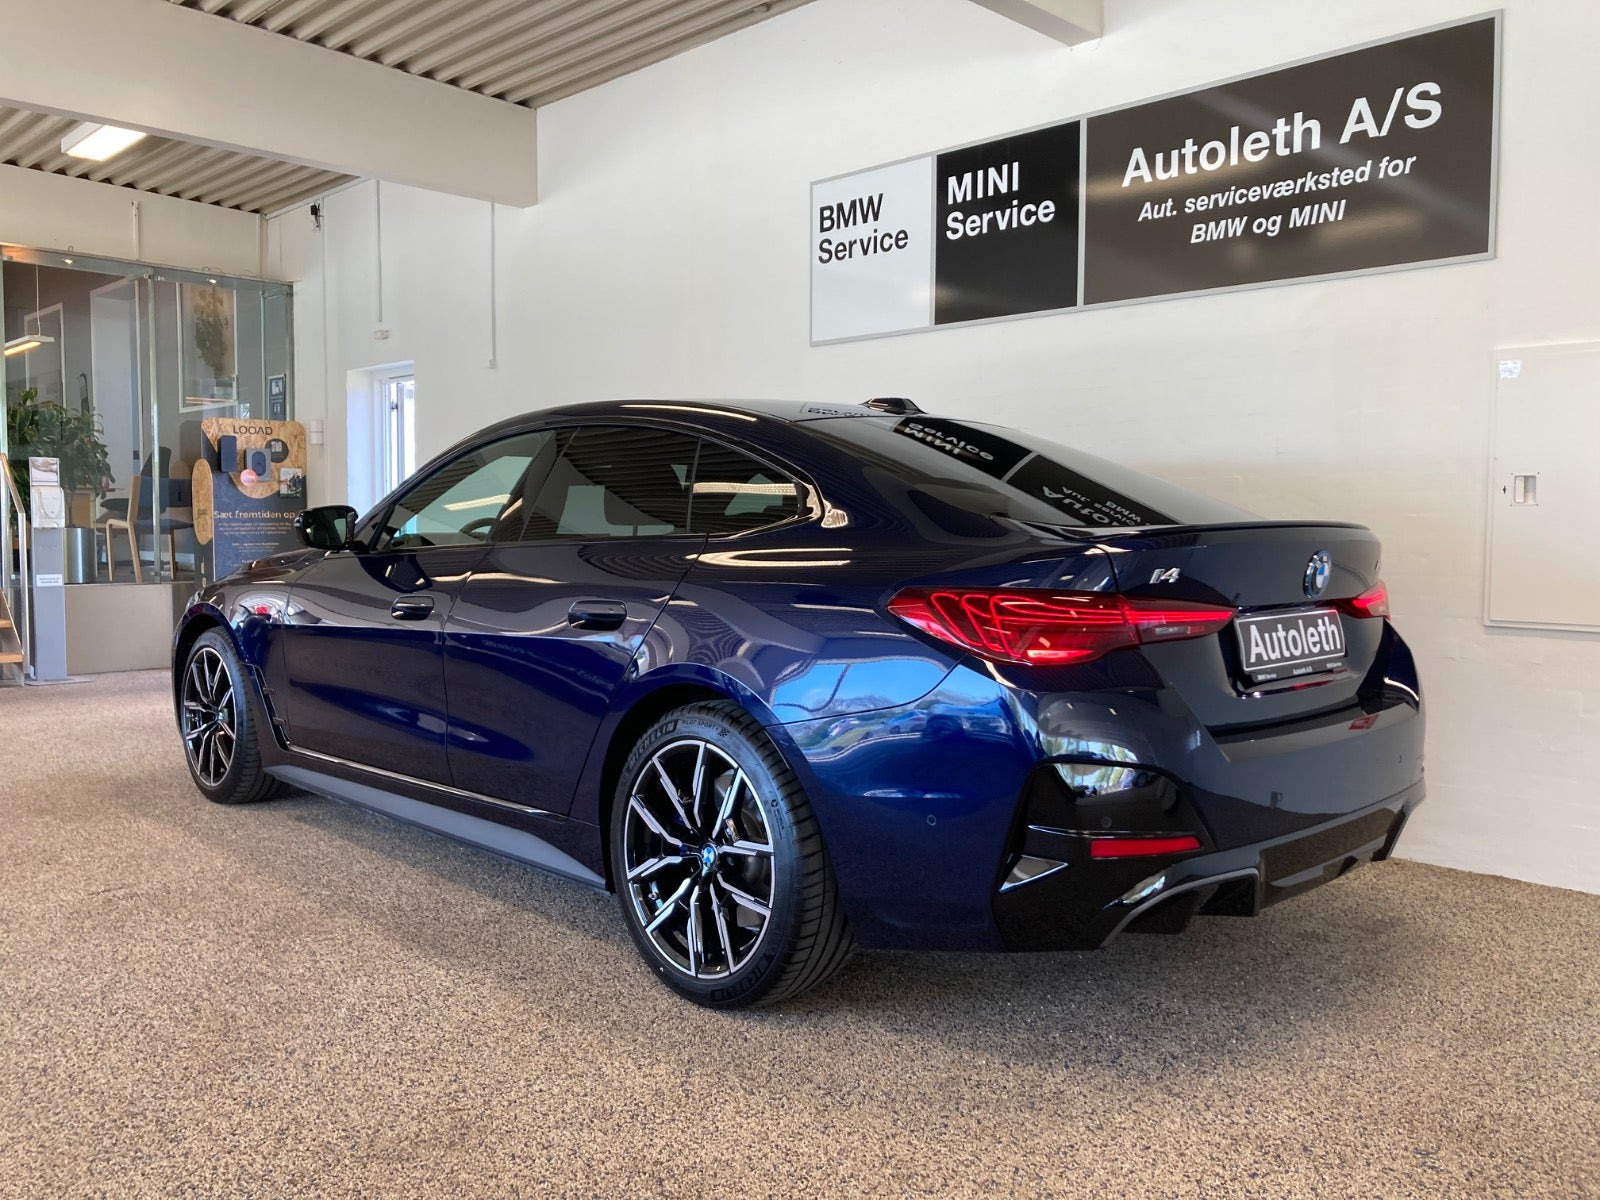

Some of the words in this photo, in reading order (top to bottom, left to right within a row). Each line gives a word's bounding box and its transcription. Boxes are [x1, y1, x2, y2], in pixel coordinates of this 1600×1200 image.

[1121, 112, 1321, 187] Autoleth
[1339, 81, 1443, 144] A/S
[947, 161, 1019, 205] MINI
[1137, 201, 1177, 222] Aut.
[1184, 160, 1370, 214] serviceværksted
[1378, 153, 1416, 180] for
[819, 193, 884, 233] BMW
[945, 200, 1056, 240] Service
[1190, 216, 1247, 244] BMW
[1252, 213, 1281, 237] og
[1288, 199, 1346, 229] MINI
[818, 228, 909, 264] Service
[233, 425, 273, 435] LOOAD
[213, 511, 232, 519] Sæt
[235, 510, 281, 519] fremtiden
[283, 512, 296, 520] op
[1149, 567, 1180, 584] i4
[1250, 616, 1341, 663] Autoleth
